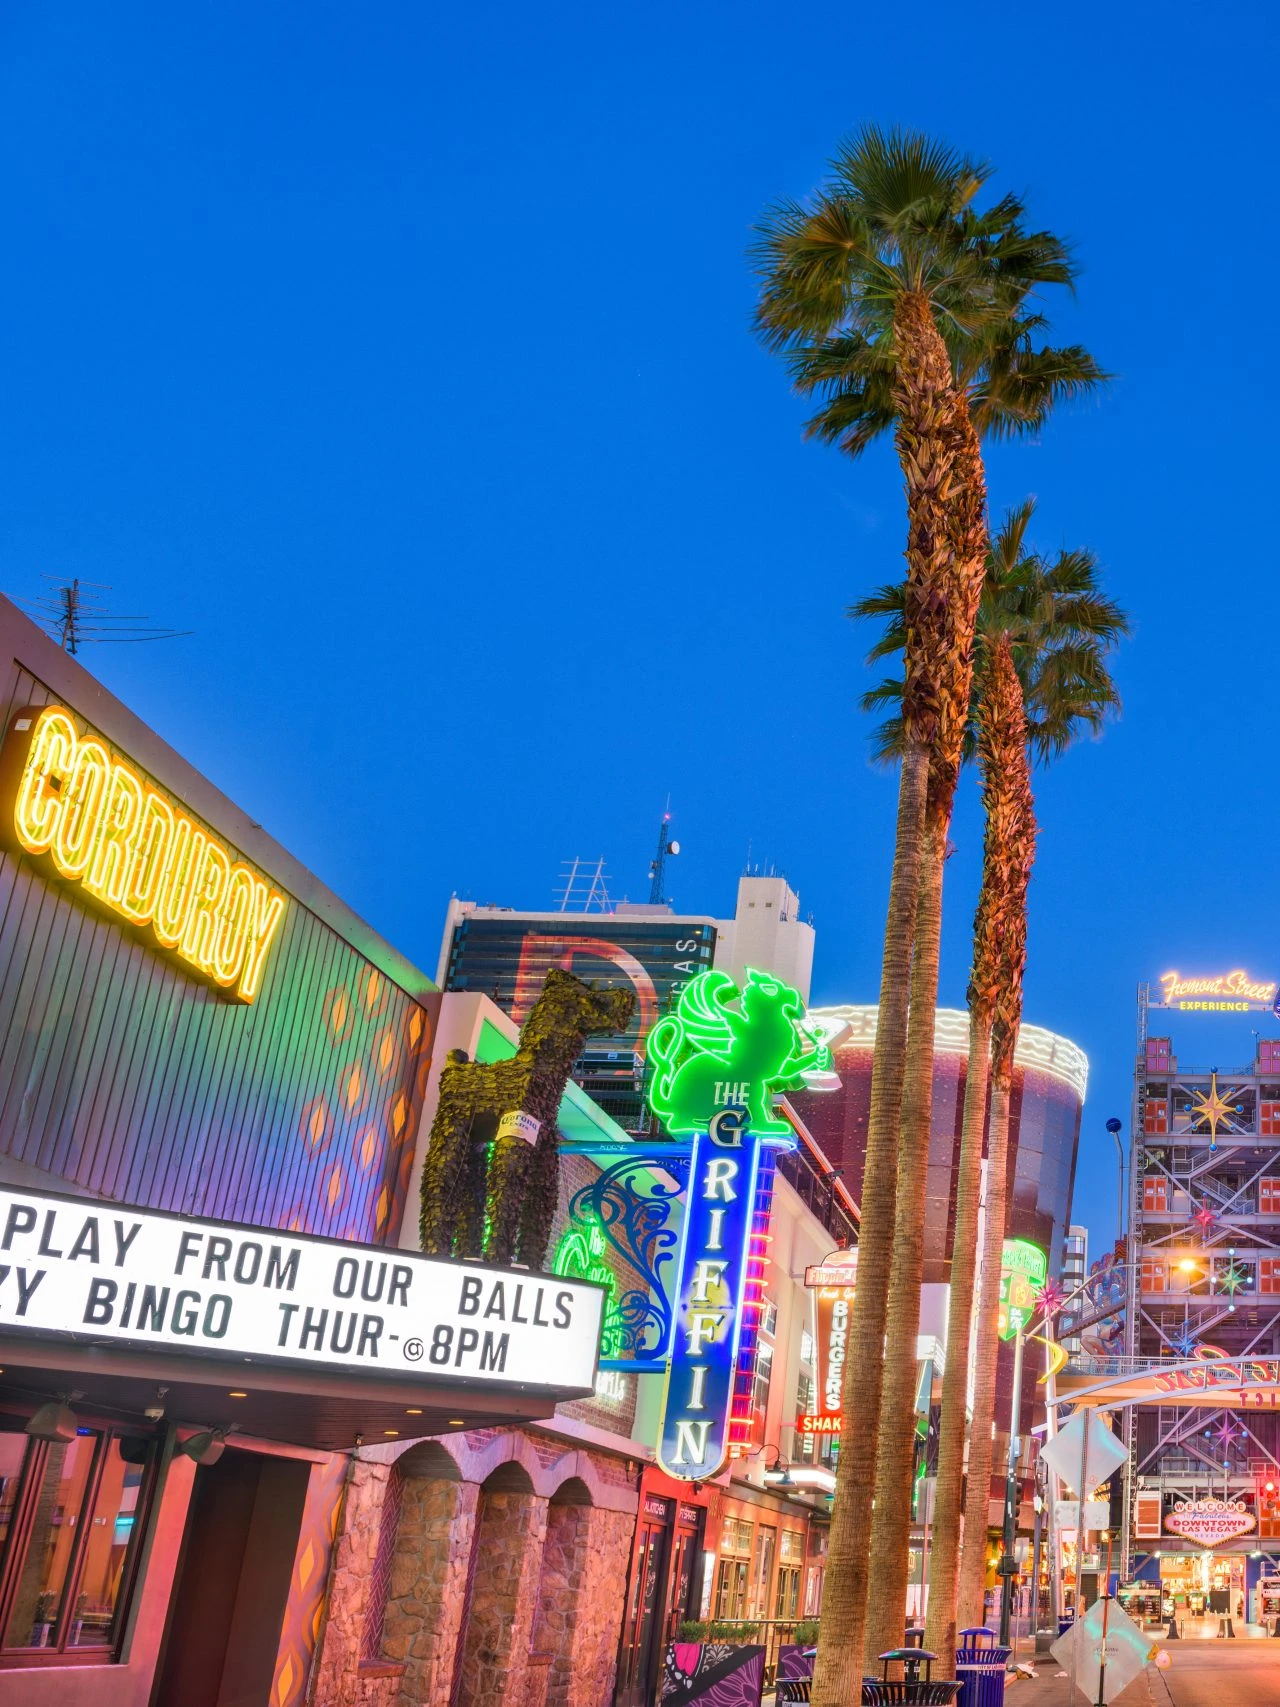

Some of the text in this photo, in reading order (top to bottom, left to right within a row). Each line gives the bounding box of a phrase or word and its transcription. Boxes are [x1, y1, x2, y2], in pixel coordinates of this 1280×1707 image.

[14, 706, 285, 1001] CORDUROY
[1160, 970, 1276, 1003] Fremont Street
[1179, 1001, 1249, 1011] EXPERIENCE
[714, 1081, 750, 1106] THE
[501, 1114, 537, 1130] Corona
[2, 1204, 142, 1267] PLAY
[174, 1231, 301, 1291] FROM
[333, 1256, 413, 1307] OUR
[458, 1275, 575, 1330] BALLS
[669, 1109, 746, 1465] GRIFFIN
[83, 1277, 233, 1339] BINGO
[825, 1300, 849, 1411] BURGERS
[803, 1416, 842, 1431] SHAK
[1175, 1502, 1246, 1512] WELCOME
[1191, 1511, 1232, 1520] Fabulous
